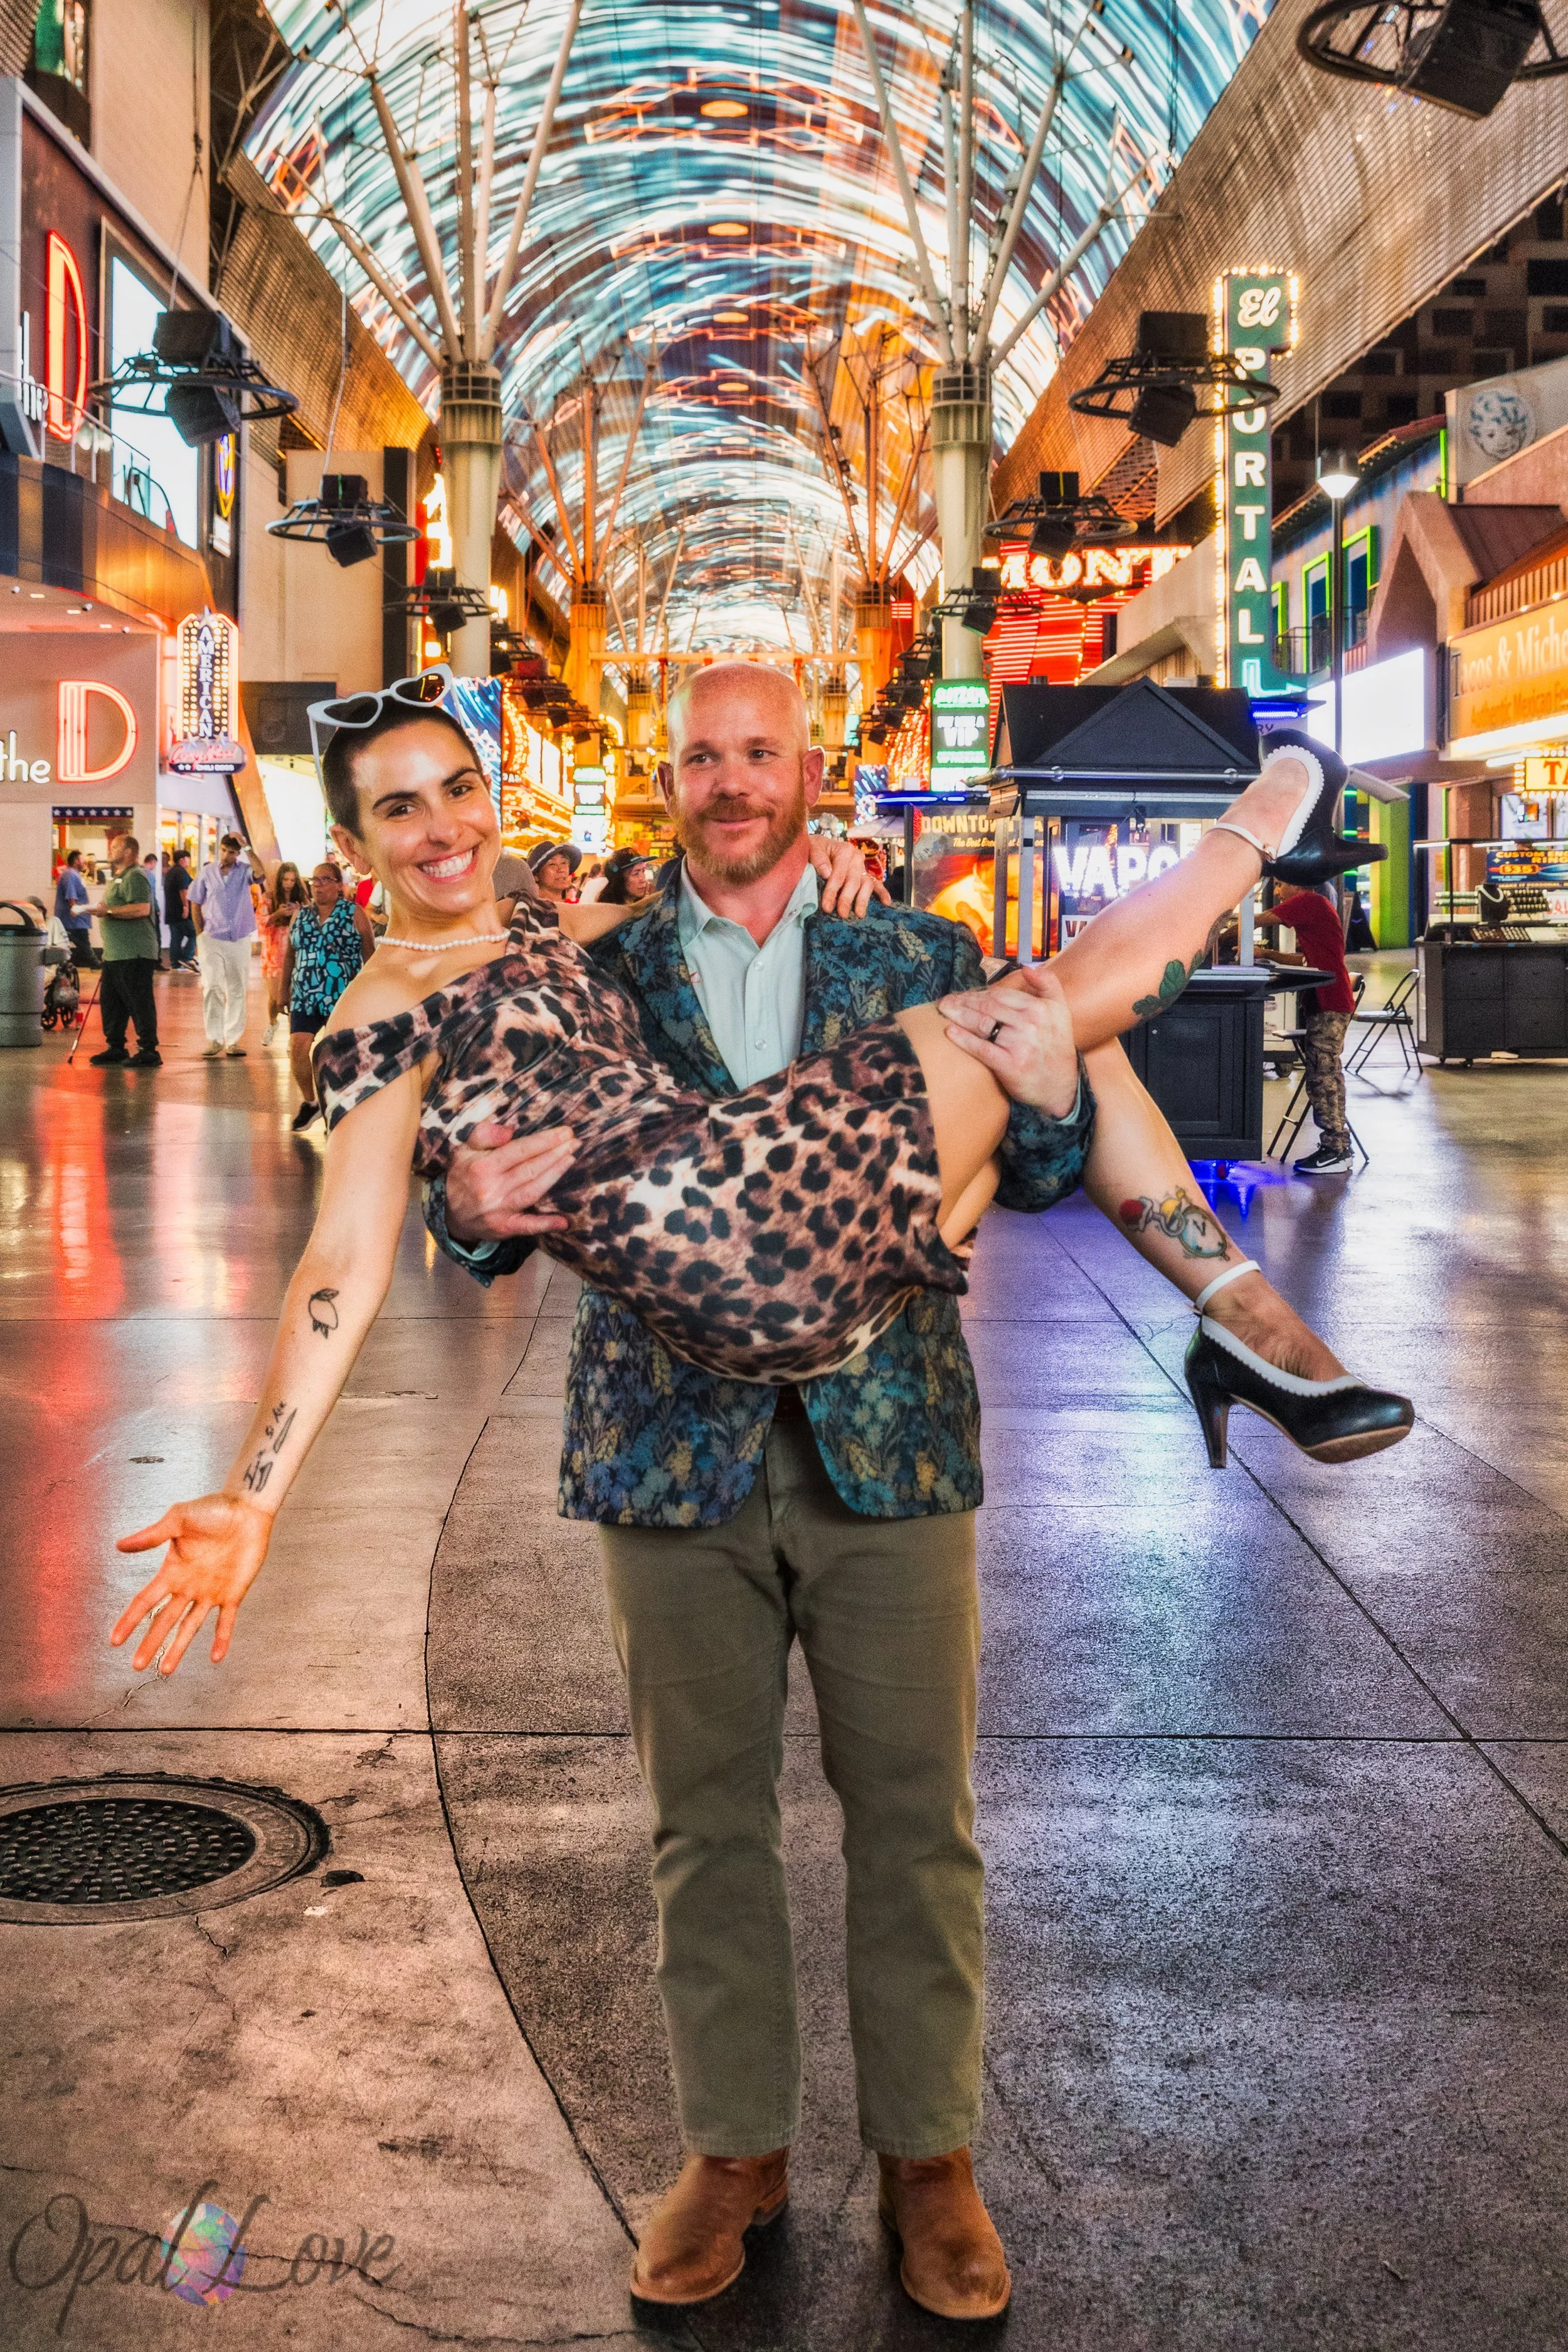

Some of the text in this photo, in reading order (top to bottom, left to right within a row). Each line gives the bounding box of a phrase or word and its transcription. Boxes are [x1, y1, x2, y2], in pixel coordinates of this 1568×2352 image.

[46, 230, 88, 442] D
[1237, 287, 1281, 328] El
[1232, 347, 1268, 644] PORTAL
[56, 679, 138, 783] D
[198, 626, 215, 737] AMERICAN
[943, 727, 979, 746] VIP
